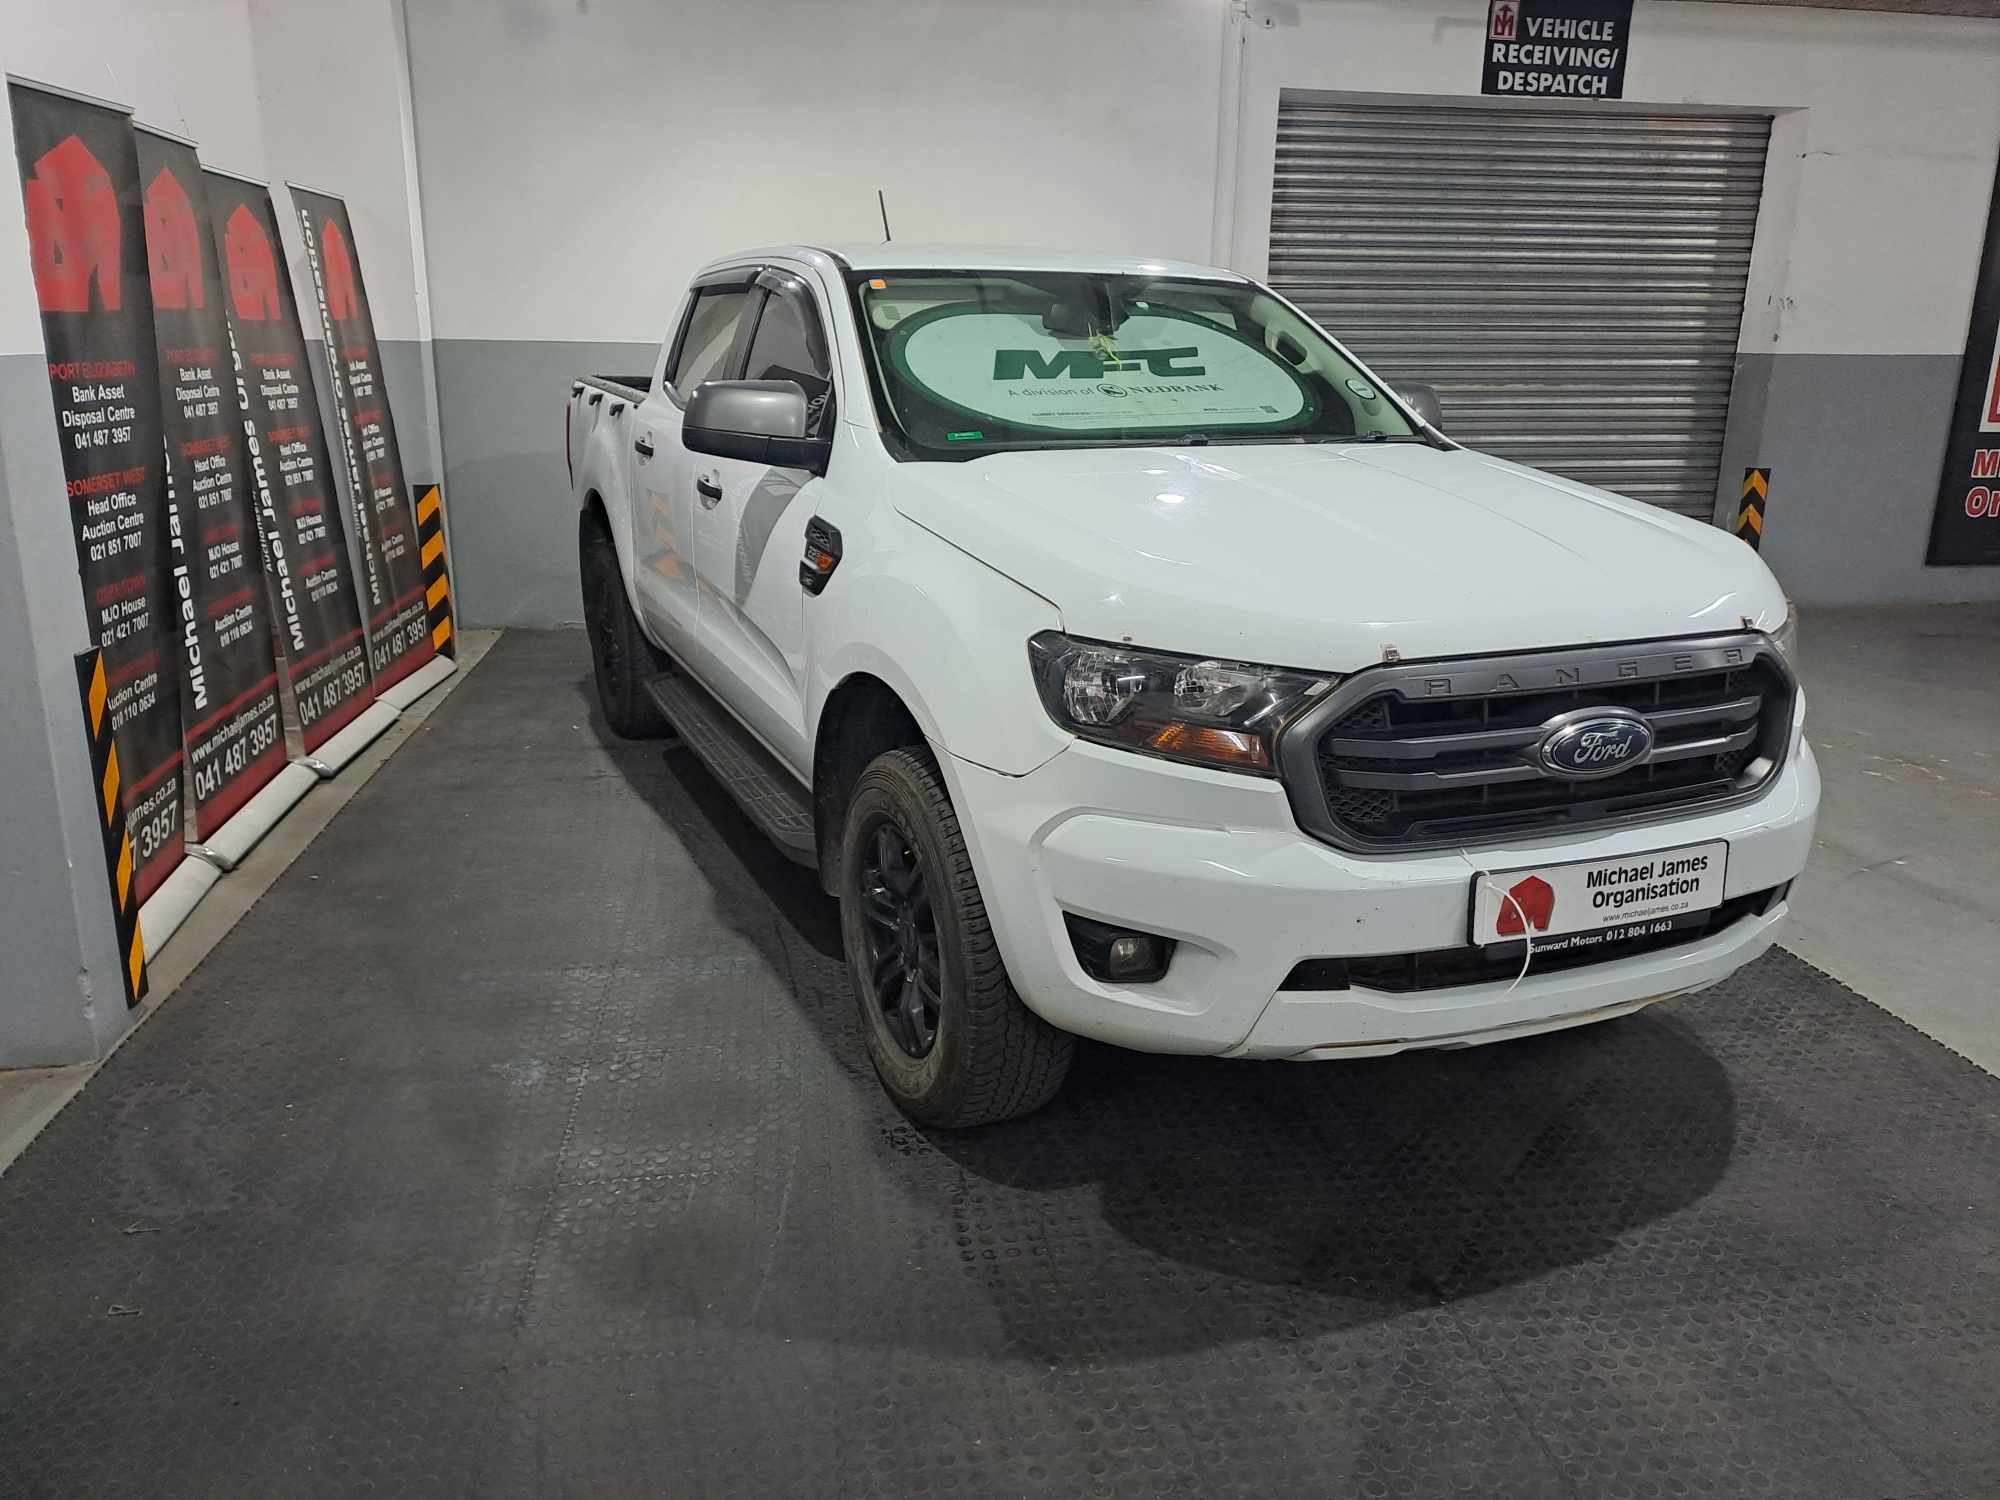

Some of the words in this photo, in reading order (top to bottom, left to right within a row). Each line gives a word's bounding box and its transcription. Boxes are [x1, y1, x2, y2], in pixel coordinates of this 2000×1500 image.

[1526, 16, 1615, 41] VEHICLE
[1492, 43, 1619, 69] RECEIVING/
[1497, 71, 1608, 95] DESPATCH
[49, 363, 80, 381] PORT
[72, 385, 96, 403] Bank
[98, 384, 125, 400] Asset
[1022, 387, 1077, 397] division
[1127, 383, 1224, 394] NEDBANK
[62, 407, 105, 429] Disposal
[107, 406, 135, 422] Centre
[74, 432, 91, 449] 041
[93, 429, 108, 446] 487
[112, 426, 131, 444] 3957
[244, 419, 276, 522] James
[87, 496, 109, 516] Head
[111, 492, 137, 510] Office
[82, 520, 116, 541] Auction
[117, 512, 144, 530] Centre
[90, 543, 106, 561] 021
[108, 537, 121, 556] 851
[123, 531, 142, 550] 7007
[357, 502, 382, 605] Michael
[267, 531, 305, 651] Michael
[101, 605, 119, 625] MJO
[121, 597, 146, 616] House
[101, 629, 115, 647] 021
[116, 620, 130, 639] 421
[132, 612, 149, 633] 7007
[173, 565, 208, 710] Michael
[374, 644, 392, 671] 041
[407, 614, 428, 645] 3957
[134, 672, 158, 695] Centre
[1424, 648, 1744, 696] RANGER
[300, 692, 321, 726] 041
[323, 679, 341, 709] 487
[342, 661, 365, 696] 3957
[124, 704, 137, 723] 110
[195, 757, 222, 801] 041
[225, 737, 248, 776] 487
[250, 713, 277, 757] 3957
[1574, 730, 1633, 763] Ford
[141, 800, 177, 858] 3957
[1586, 862, 1654, 889] Michael
[1658, 855, 1708, 878] James
[1592, 877, 1700, 908] Organisation
[1602, 901, 1689, 923] www.michaeljames.co.za
[1529, 939, 1568, 954] Sunward
[1570, 934, 1603, 948] Motors
[1606, 929, 1625, 942] 012
[1627, 925, 1646, 938] 804
[1649, 920, 1673, 934] 1663
